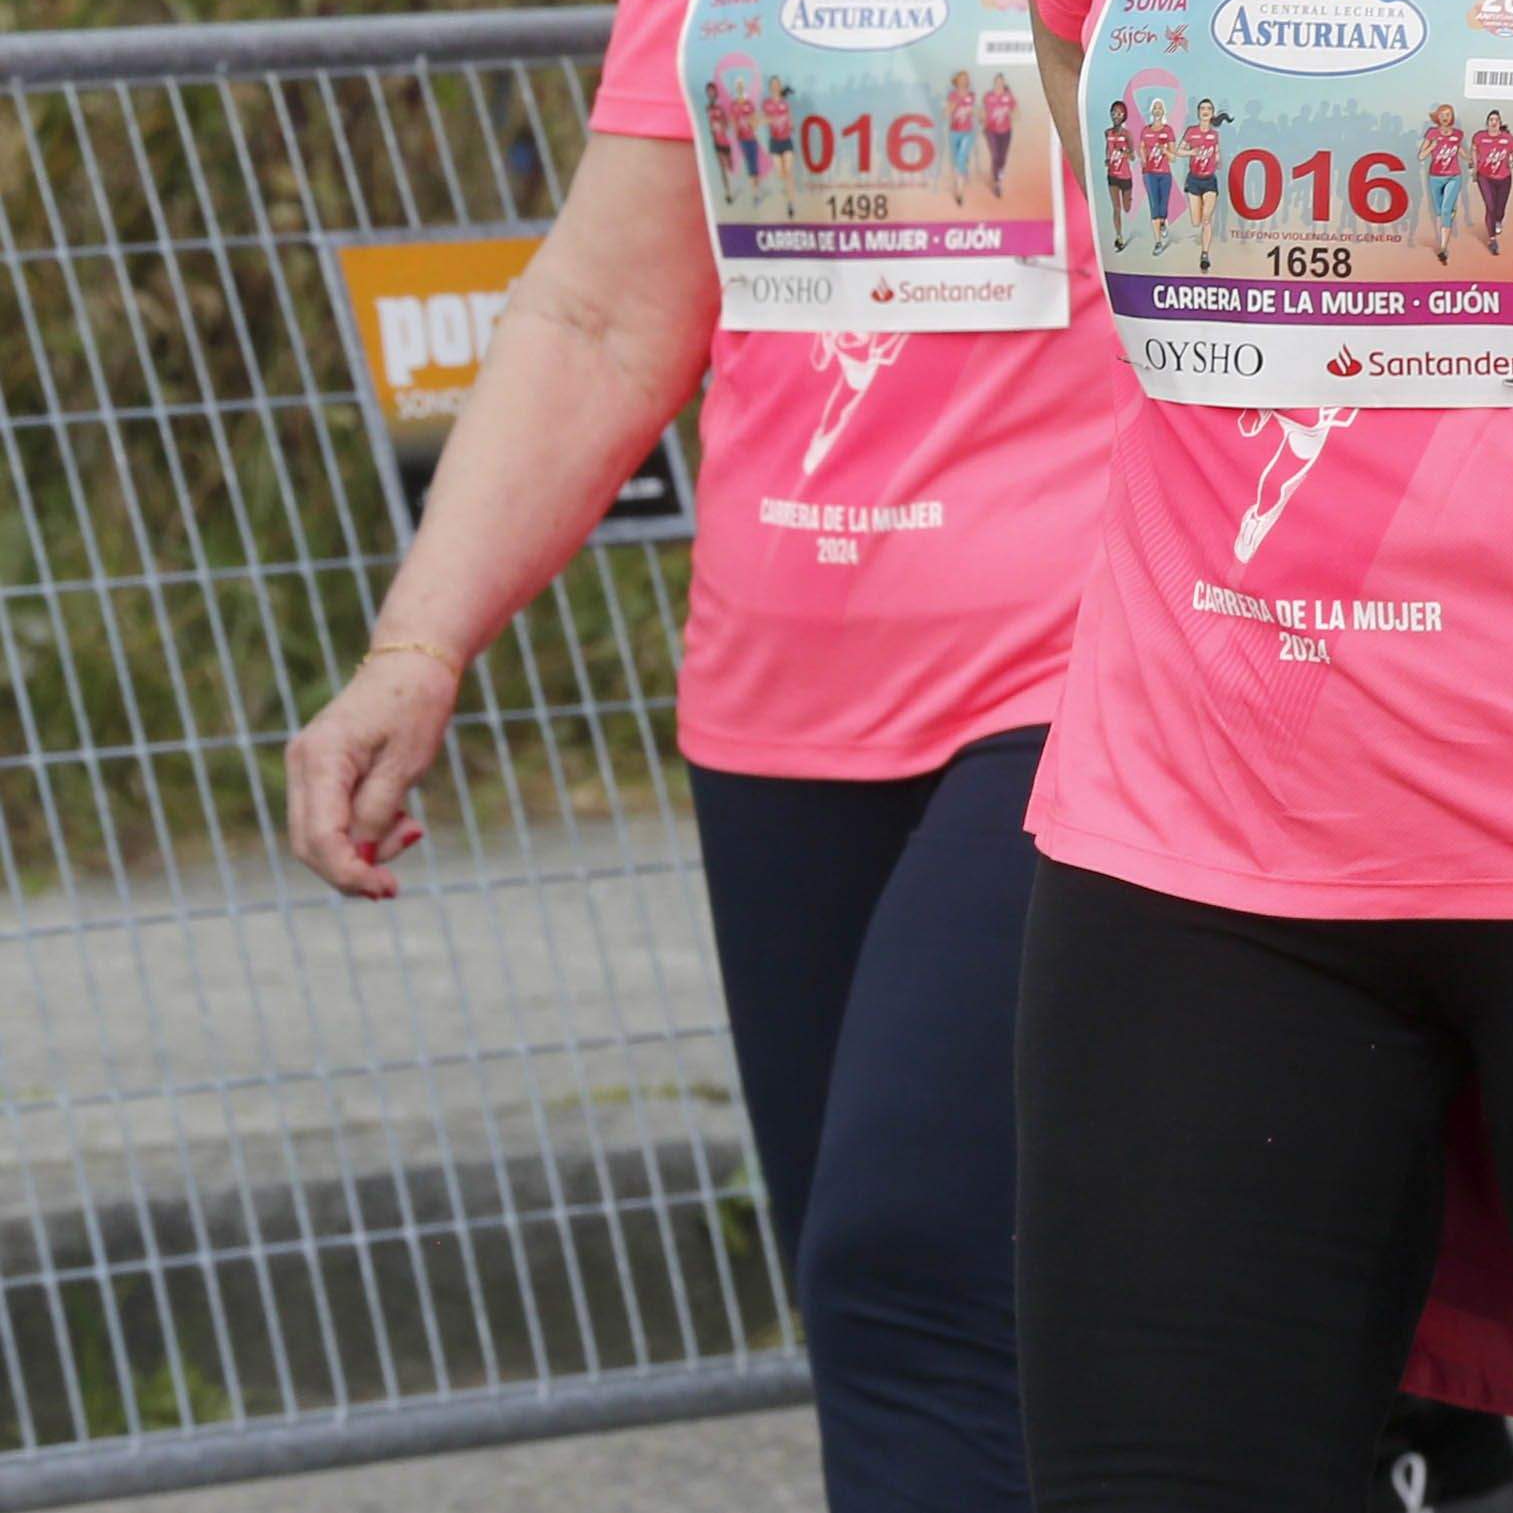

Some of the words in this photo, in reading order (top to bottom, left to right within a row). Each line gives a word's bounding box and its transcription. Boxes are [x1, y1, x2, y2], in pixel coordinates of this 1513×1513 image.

[1225, 5, 1411, 51] ASTURIANA
[1259, 3, 1329, 17] CENTRAL
[1333, 5, 1406, 19] LECHERA
[800, 113, 937, 174] 016
[1227, 148, 1410, 224] 016
[825, 193, 889, 221] 1498
[838, 229, 862, 252] LA
[864, 228, 929, 252] MUJER
[943, 222, 1003, 252] GIJÓN
[1266, 244, 1353, 279] 1658
[751, 275, 833, 305] OYSHO
[899, 280, 1016, 304] Santander
[1153, 284, 1242, 312] CARRERA
[1246, 289, 1276, 314] DE
[1283, 291, 1315, 315] LA
[1320, 291, 1405, 316] MUJER
[1428, 284, 1501, 315] GIJÓN
[1144, 338, 1265, 378] OYSHO
[871, 500, 943, 533] MUJER
[816, 536, 859, 565] 2024
[1192, 579, 1276, 624] CARRERA
[1275, 599, 1307, 631] DE
[1314, 599, 1346, 631] LA
[1352, 599, 1443, 632] MUJER
[1279, 630, 1332, 665] 2024
